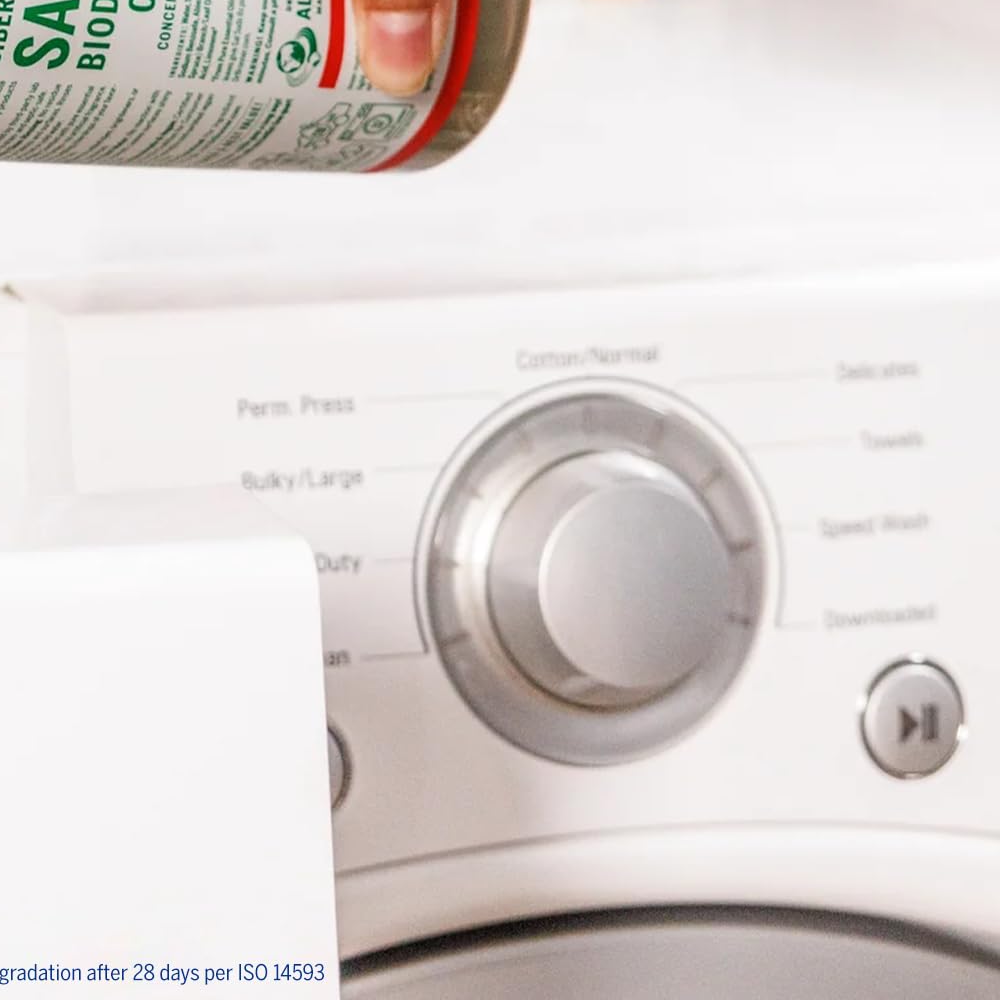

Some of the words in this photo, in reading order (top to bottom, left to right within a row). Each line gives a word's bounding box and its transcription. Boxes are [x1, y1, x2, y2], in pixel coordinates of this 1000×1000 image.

[257, 12, 268, 33] Keep
[515, 344, 660, 371] Cotton/Normal
[237, 397, 292, 420] Perm.
[300, 395, 356, 416] Press
[241, 469, 364, 493] Bulky/Large
[820, 517, 873, 537] Speed
[314, 552, 362, 575] Duty
